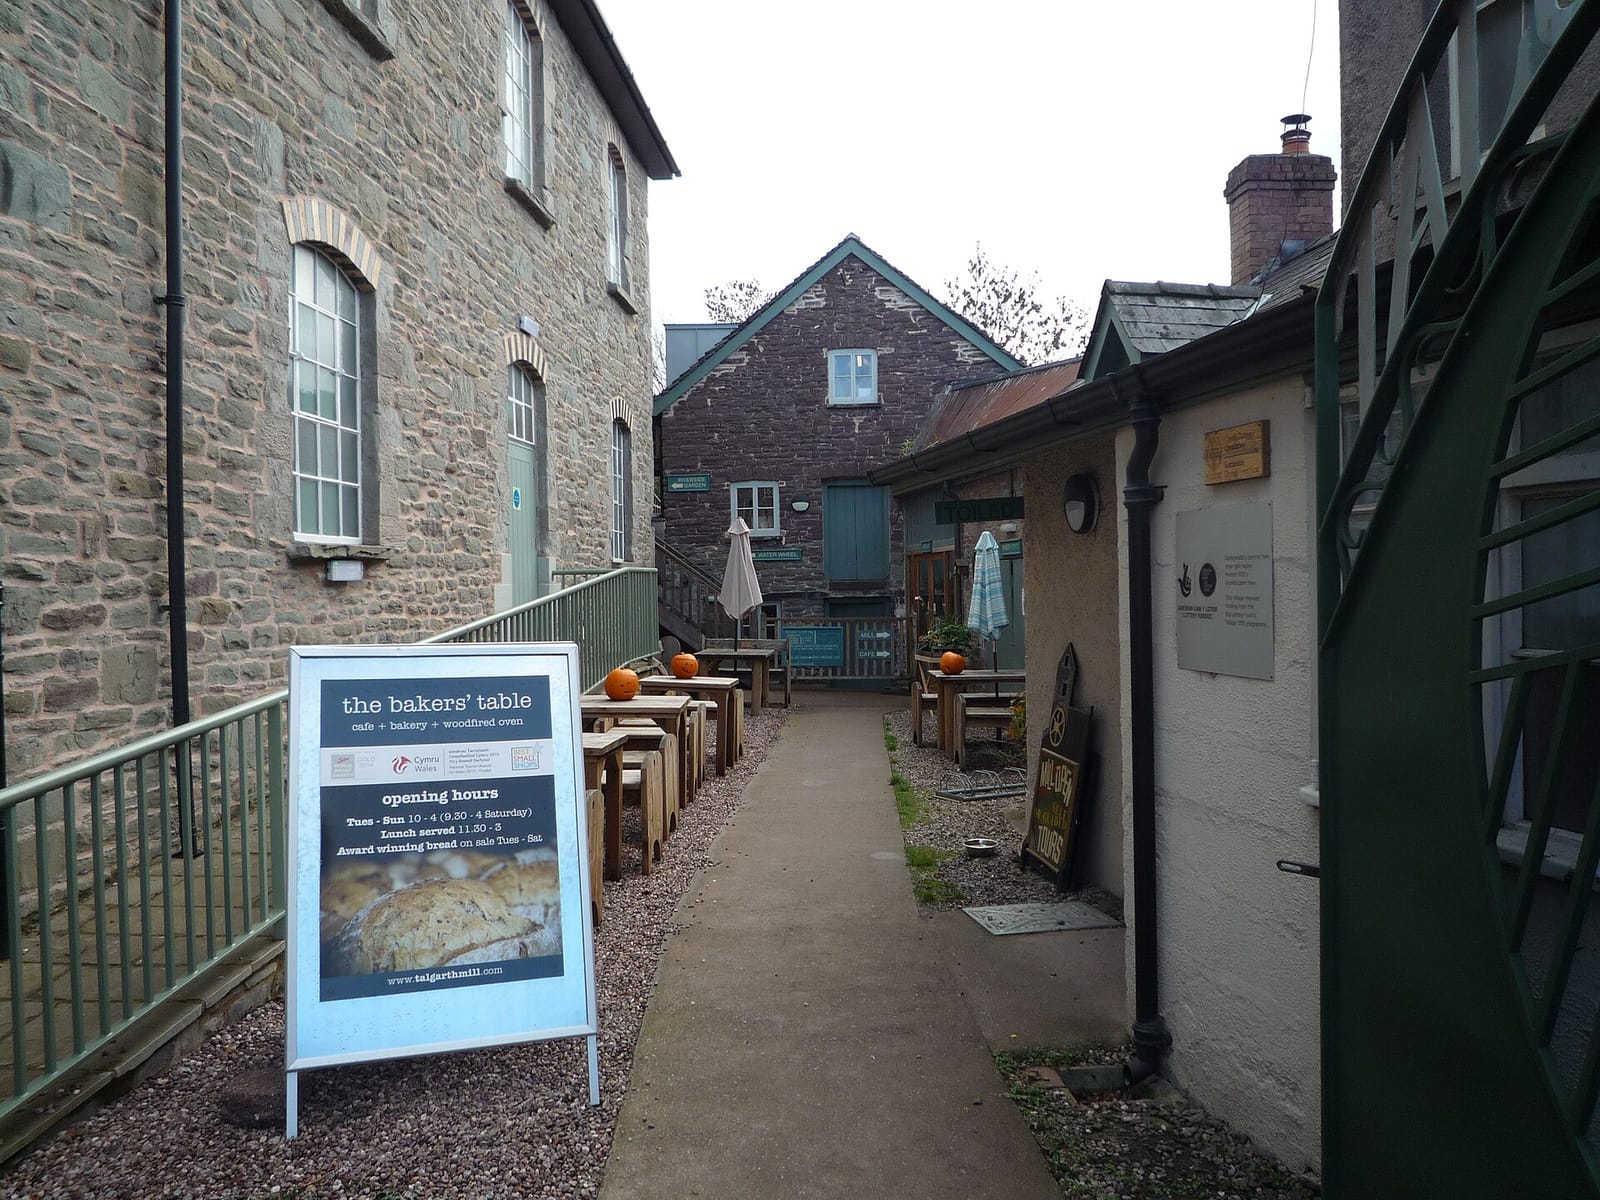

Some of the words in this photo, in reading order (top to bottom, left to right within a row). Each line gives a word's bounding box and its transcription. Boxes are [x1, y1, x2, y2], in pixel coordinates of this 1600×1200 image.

[343, 697, 382, 714] the
[477, 692, 532, 710] table
[352, 721, 375, 731] cafe
[390, 720, 428, 732] bakery
[443, 718, 496, 729] woodfired
[498, 717, 524, 727] oven
[414, 755, 440, 766] Cymru
[414, 764, 437, 773] Wales
[1055, 764, 1073, 807] OPEN
[382, 791, 449, 808] opening
[452, 788, 499, 802] hours
[347, 817, 374, 827] Tues
[383, 815, 405, 826] Sun
[408, 814, 421, 824] 10
[430, 813, 437, 823] 4
[475, 810, 483, 820] 4
[484, 807, 533, 821] Saturday)
[380, 829, 416, 840] Lunch
[419, 826, 455, 837] served
[458, 824, 487, 835] 11.30
[495, 823, 502, 832] 3
[337, 845, 375, 856] Award
[377, 841, 424, 855] winning
[427, 839, 457, 850] bread
[460, 840, 473, 848] on
[475, 837, 494, 847] sale
[497, 835, 519, 845] Tues
[528, 834, 542, 843] Sat
[1037, 824, 1064, 864] TOURS
[387, 966, 503, 986] www.talgarthmill.com
